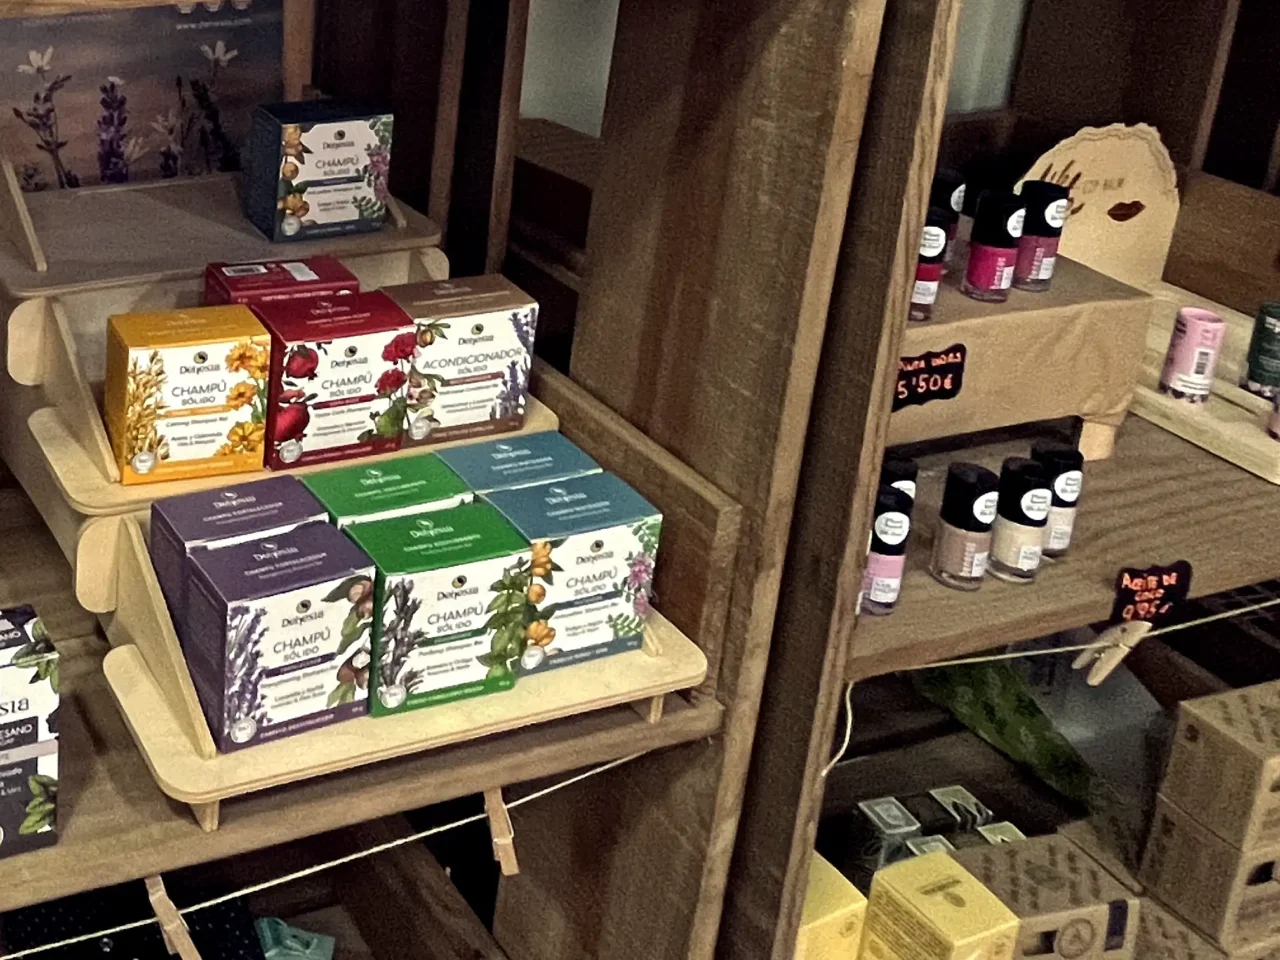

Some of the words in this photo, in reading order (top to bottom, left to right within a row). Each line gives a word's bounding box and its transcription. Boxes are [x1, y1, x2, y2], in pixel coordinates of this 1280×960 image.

[423, 347, 522, 369] ACONDICIONADOR
[172, 380, 226, 397] CHAMPÚ
[322, 371, 372, 389] CHAMPÚ
[182, 396, 215, 405] SÓLIDO
[330, 387, 361, 397] SÓLIDO
[566, 568, 618, 588] CHAMPÚ
[428, 602, 484, 625] CHAMPÚ
[437, 620, 472, 633] SÓLIDO
[274, 627, 330, 654] CHAMPÚ
[284, 646, 319, 660] SÓLIDO
